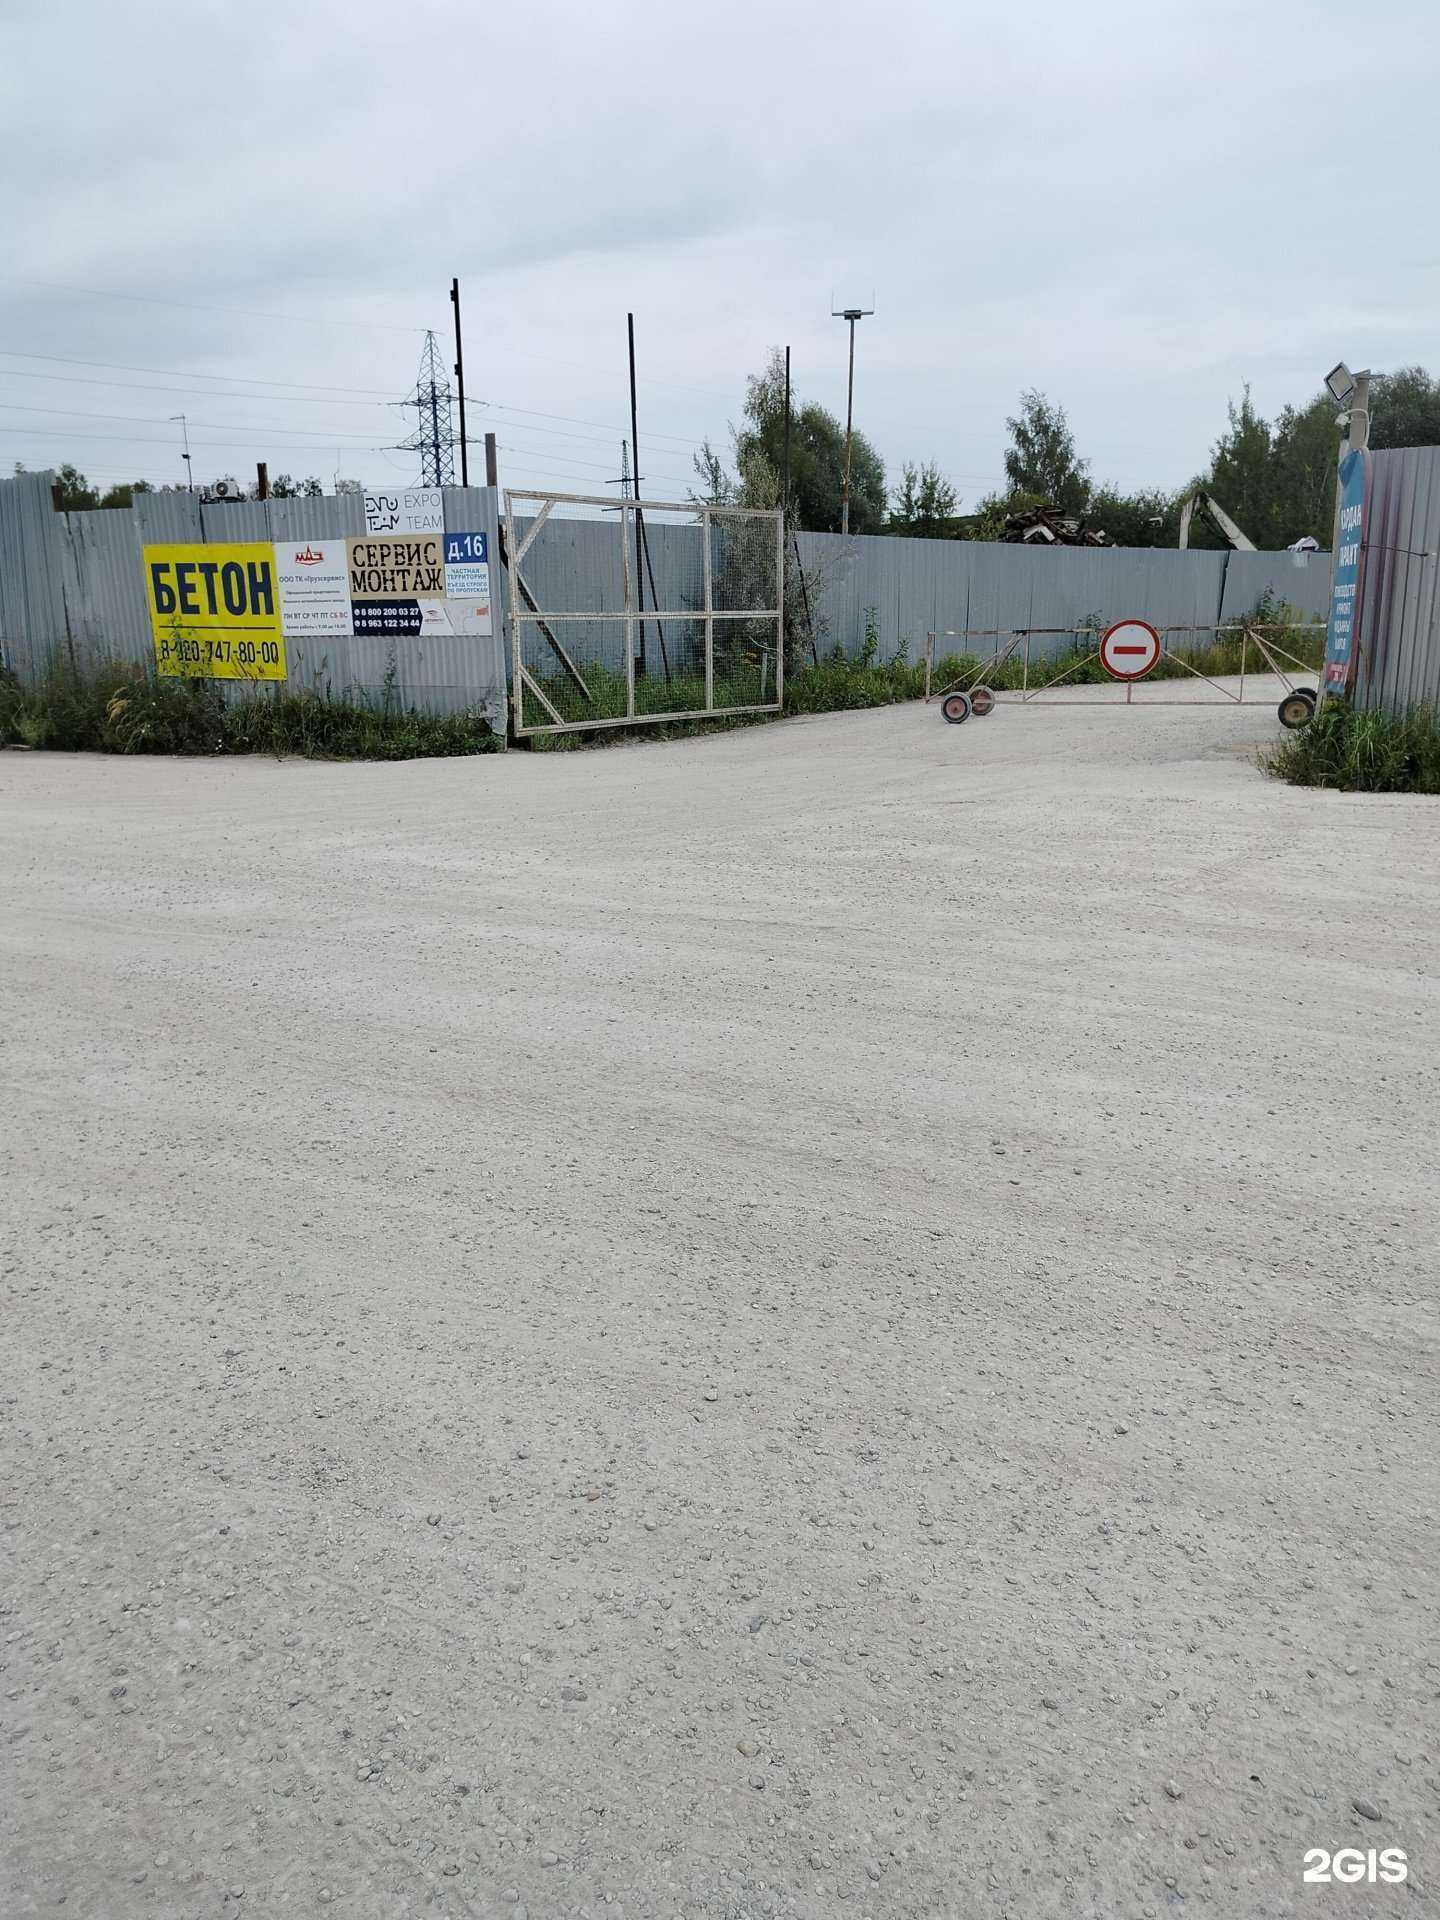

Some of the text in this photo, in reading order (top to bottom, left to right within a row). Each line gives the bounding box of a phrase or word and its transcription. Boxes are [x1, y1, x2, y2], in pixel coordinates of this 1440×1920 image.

[404, 493, 441, 509] EXPO
[406, 515, 443, 529] TEAM
[352, 542, 437, 567] СЕРВИС
[150, 561, 275, 616] БЕТОН
[351, 568, 443, 592] МОНТАЖ
[383, 608, 398, 616] 200
[409, 607, 420, 616] 27
